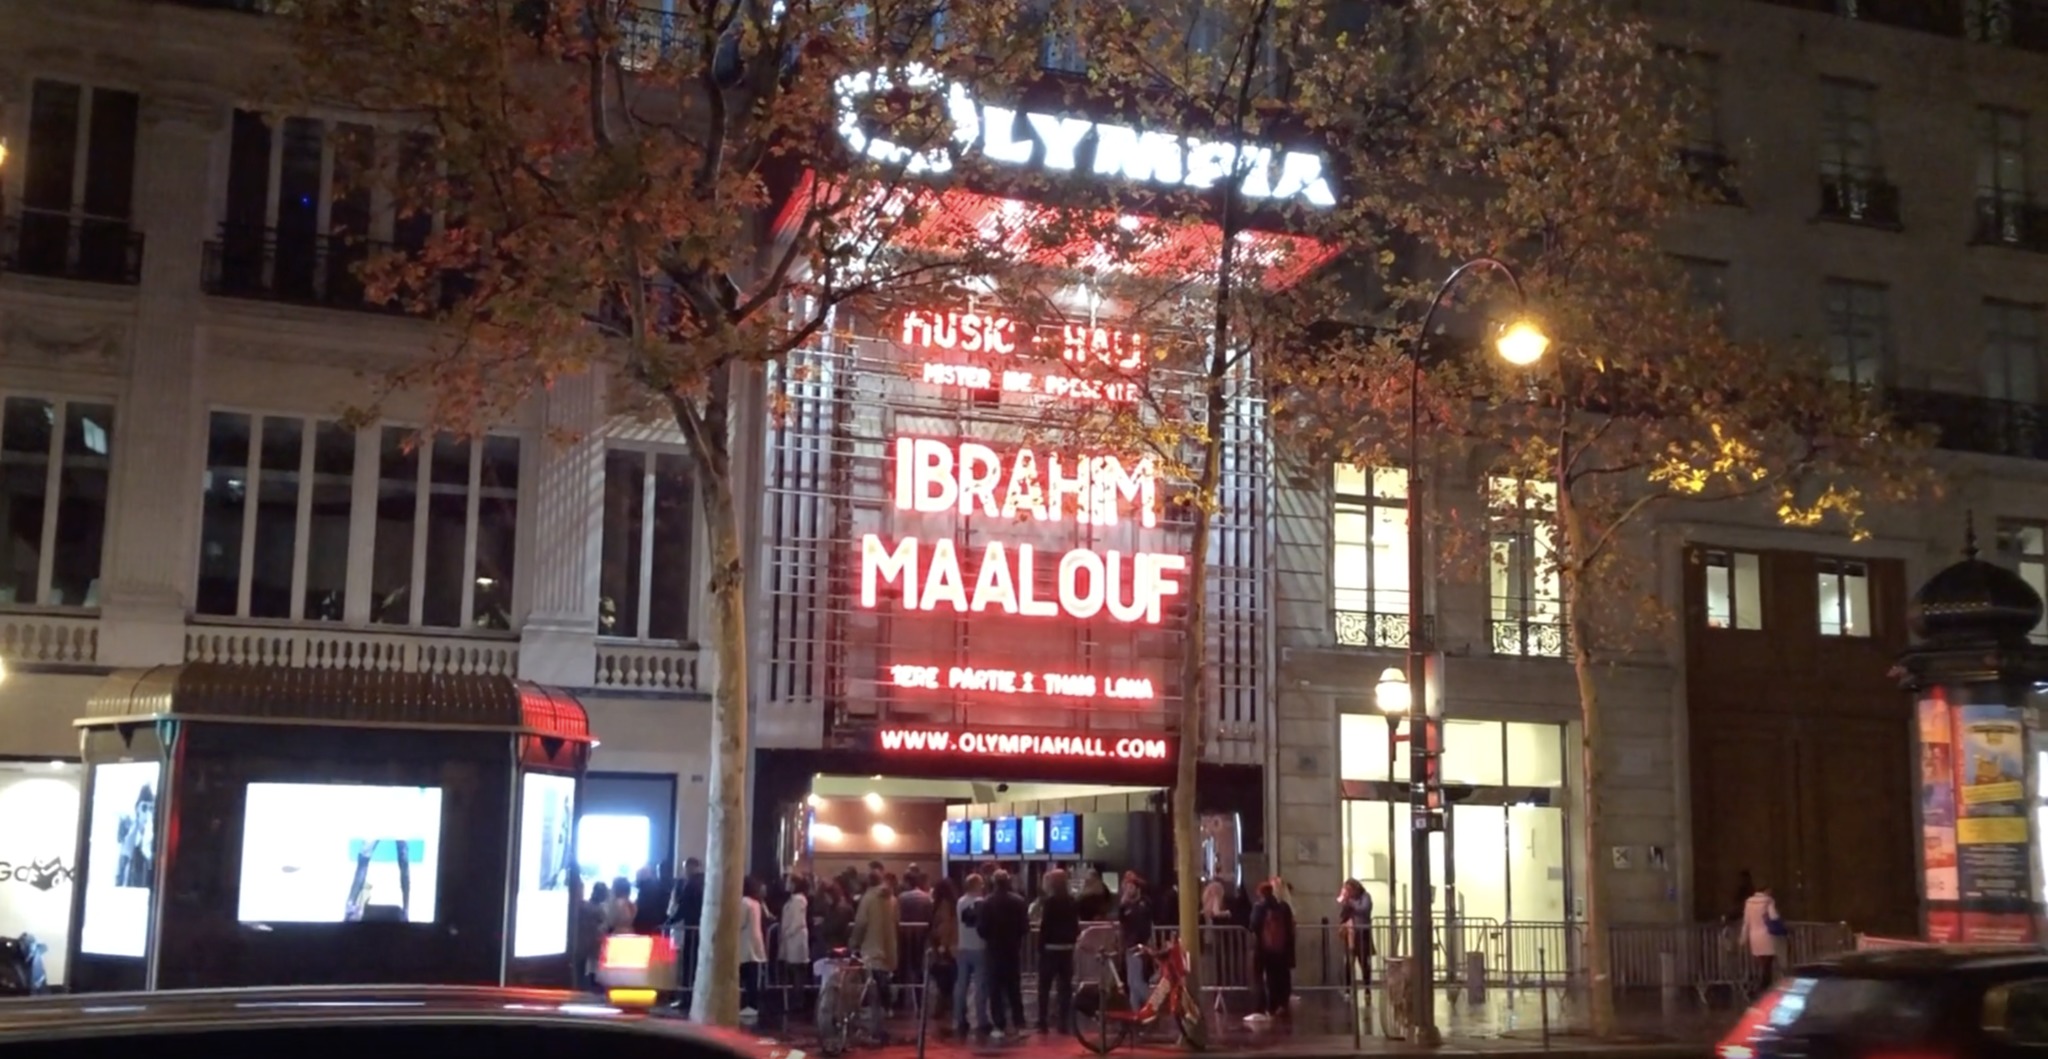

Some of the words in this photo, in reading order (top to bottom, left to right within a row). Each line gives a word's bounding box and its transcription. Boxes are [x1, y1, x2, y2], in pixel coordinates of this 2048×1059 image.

[834, 62, 1336, 206] OLYMPIA
[902, 310, 1015, 353] MUSIC
[895, 437, 1156, 528] IBRAHIM
[860, 533, 1186, 624] MAALOUF
[949, 667, 1017, 693] PARTIE
[880, 730, 1167, 758] WWW.OLYMPIAHALL.COM
